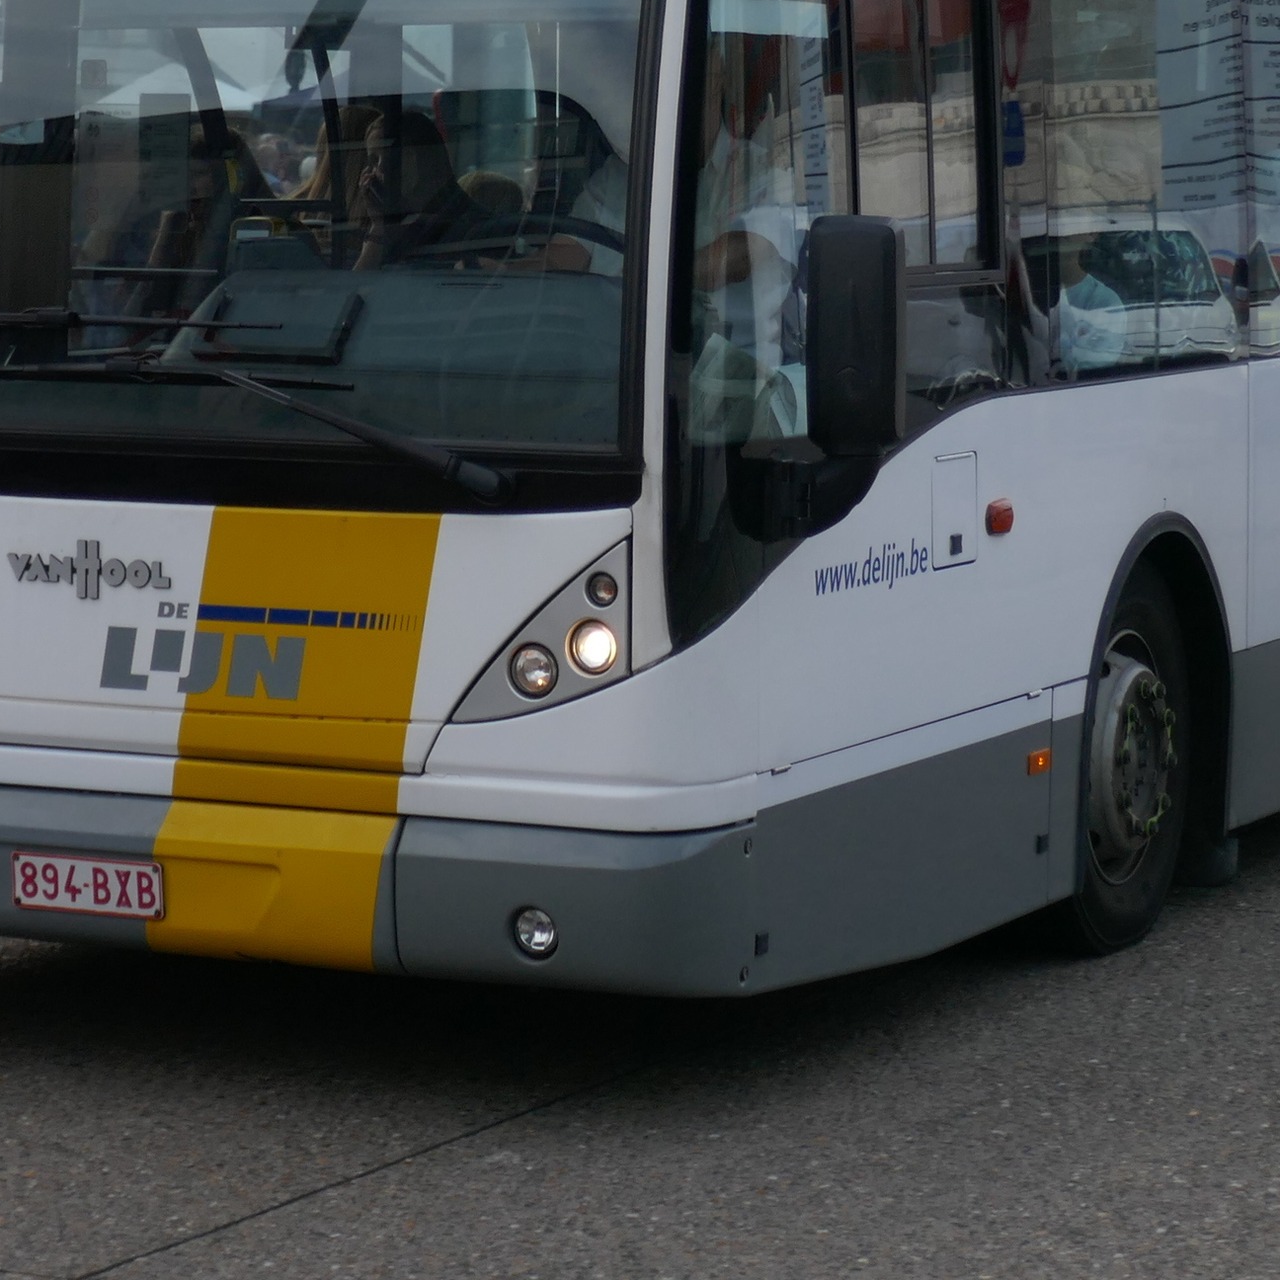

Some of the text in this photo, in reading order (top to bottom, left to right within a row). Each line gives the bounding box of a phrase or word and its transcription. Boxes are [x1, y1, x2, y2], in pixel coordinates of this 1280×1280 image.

[814, 537, 928, 596] www.delijn.be
[157, 601, 190, 620] DE
[99, 625, 307, 701] LIJN
[19, 861, 156, 910] 894-BXB
